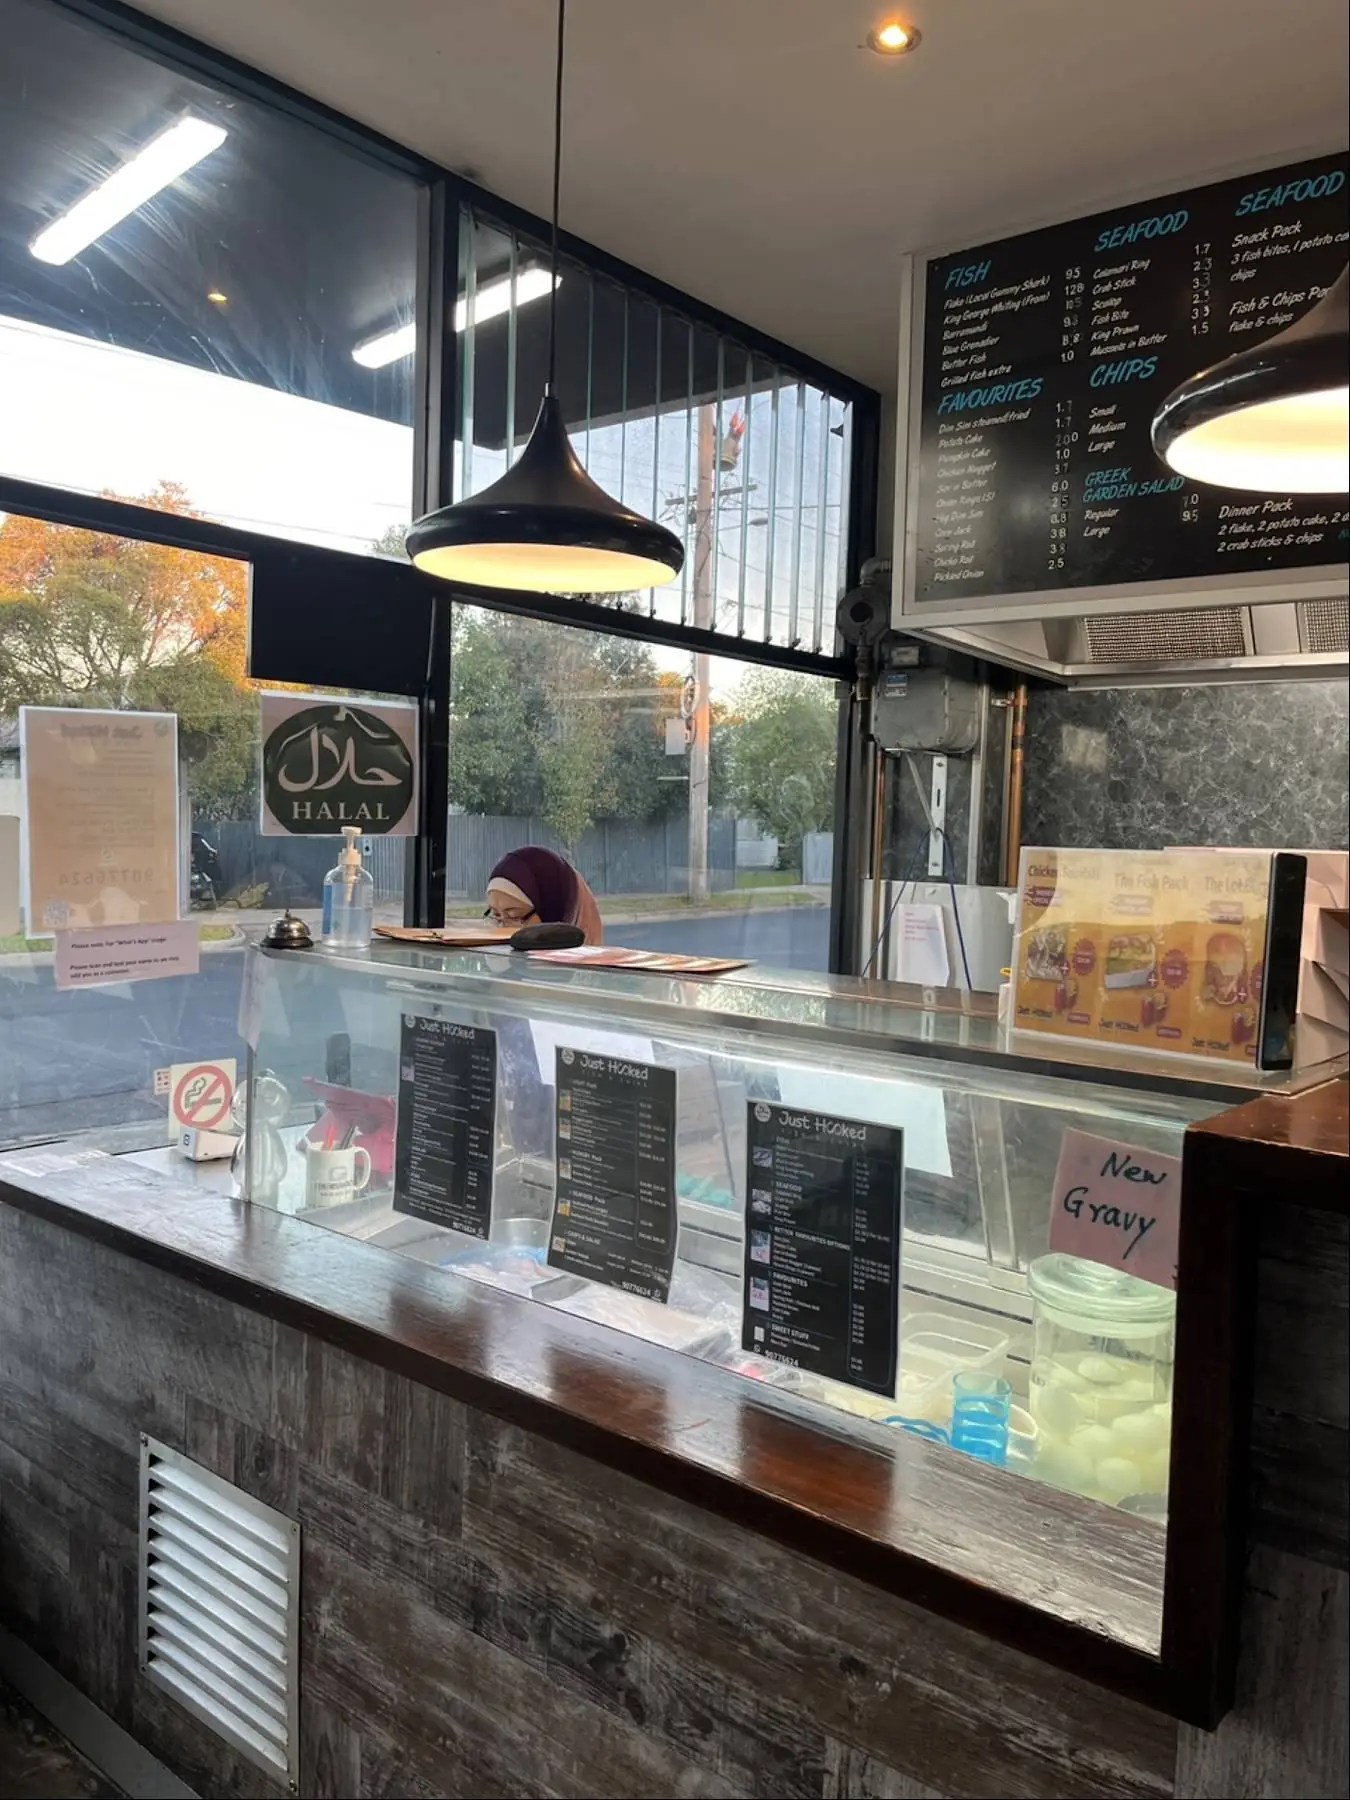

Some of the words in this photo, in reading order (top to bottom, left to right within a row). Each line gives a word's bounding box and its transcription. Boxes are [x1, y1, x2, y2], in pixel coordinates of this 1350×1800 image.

[1235, 171, 1345, 216] SEAFOOD
[1094, 210, 1188, 251] SEAFOOD
[1232, 228, 1269, 247] Snack
[1271, 220, 1303, 239] Pack
[1231, 253, 1240, 264] 3
[1241, 248, 1262, 261] fish
[1299, 234, 1333, 252] potato
[945, 260, 991, 290] FISH
[1131, 258, 1151, 272] Ring
[1229, 268, 1256, 281] chips
[1092, 281, 1114, 296] Crab
[1114, 276, 1137, 291] Stick
[1229, 300, 1256, 317] Fish
[1257, 296, 1270, 311] &
[1271, 291, 1304, 309] Chips
[944, 315, 961, 325] King
[962, 308, 990, 321] George
[1229, 319, 1253, 333] flake
[1255, 316, 1266, 327] &
[1266, 312, 1294, 326] chips
[1090, 329, 1111, 342] King
[1112, 324, 1140, 338] Prawn
[968, 352, 988, 365] Fish
[941, 371, 970, 388] Grilled
[1090, 356, 1158, 387] CHIPS
[937, 378, 1044, 414] FAVOURITES
[1089, 404, 1118, 419] Small
[1088, 421, 1127, 435] Medium
[1087, 440, 1116, 454] Large
[1085, 467, 1132, 487] GREEK
[1082, 482, 1140, 503] GARDEN
[1140, 476, 1186, 497] SALAD
[1084, 508, 1121, 522] Regular
[1219, 504, 1260, 519] Dinner
[1262, 498, 1294, 513] Pack
[1083, 525, 1111, 539] Large
[1217, 525, 1227, 536] 2
[1257, 521, 1267, 532] 2
[1266, 517, 1300, 533] potato
[1301, 514, 1329, 527] cake,
[1330, 512, 1341, 524] 2
[1217, 542, 1226, 553] 2
[1226, 538, 1251, 552] crab
[1251, 536, 1283, 549] sticks
[1283, 534, 1295, 545] &
[1296, 532, 1324, 545] chips
[278, 726, 402, 792] حلال
[292, 801, 390, 820] HALAL
[580, 1055, 604, 1070] Just
[608, 1061, 648, 1080] Hooked
[778, 1111, 810, 1129] Just
[815, 1117, 867, 1141] Hooked
[1100, 1151, 1167, 1184] New
[1064, 1186, 1156, 1260] Gravy
